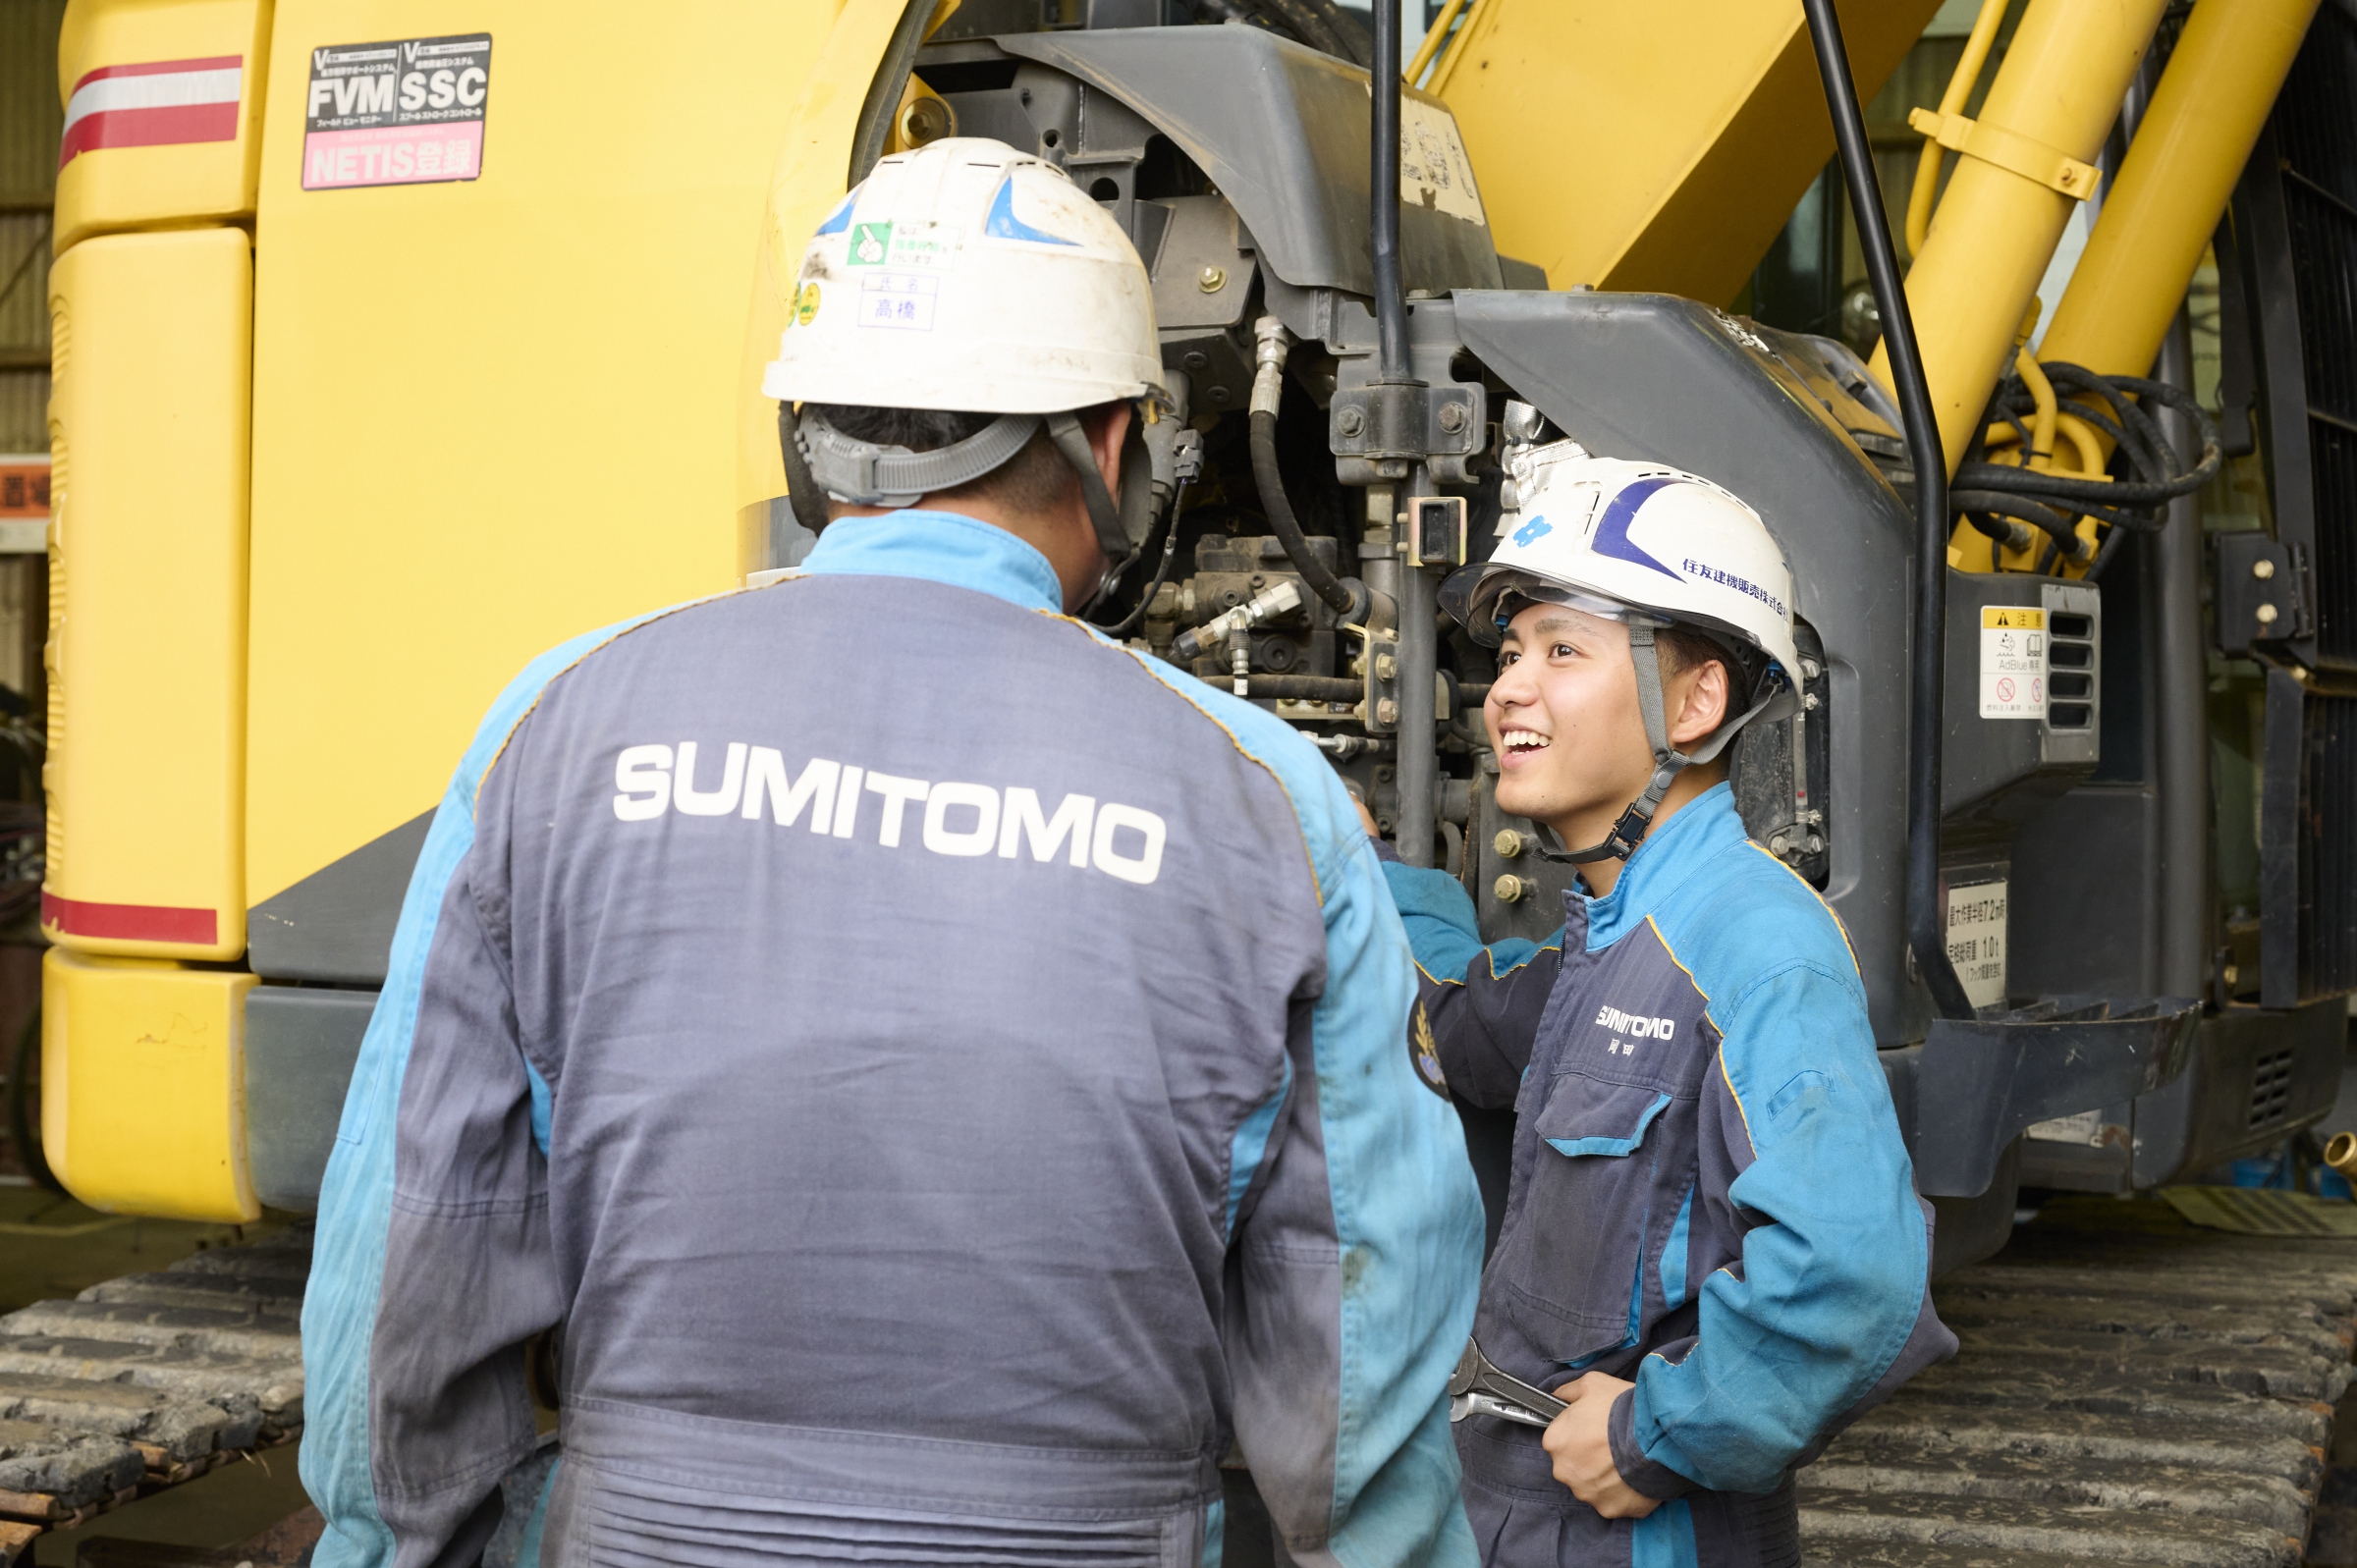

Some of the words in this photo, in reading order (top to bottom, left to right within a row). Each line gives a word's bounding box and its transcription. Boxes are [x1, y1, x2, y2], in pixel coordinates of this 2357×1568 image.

[307, 75, 395, 118] FVM
[399, 67, 487, 111] SSC
[310, 138, 471, 184] NETIS登録
[875, 298, 915, 320] 高橋
[1999, 660, 2028, 671] AdBlue
[613, 740, 1167, 885] SUMITOMO
[1595, 1004, 1675, 1041] SUMITOMO
